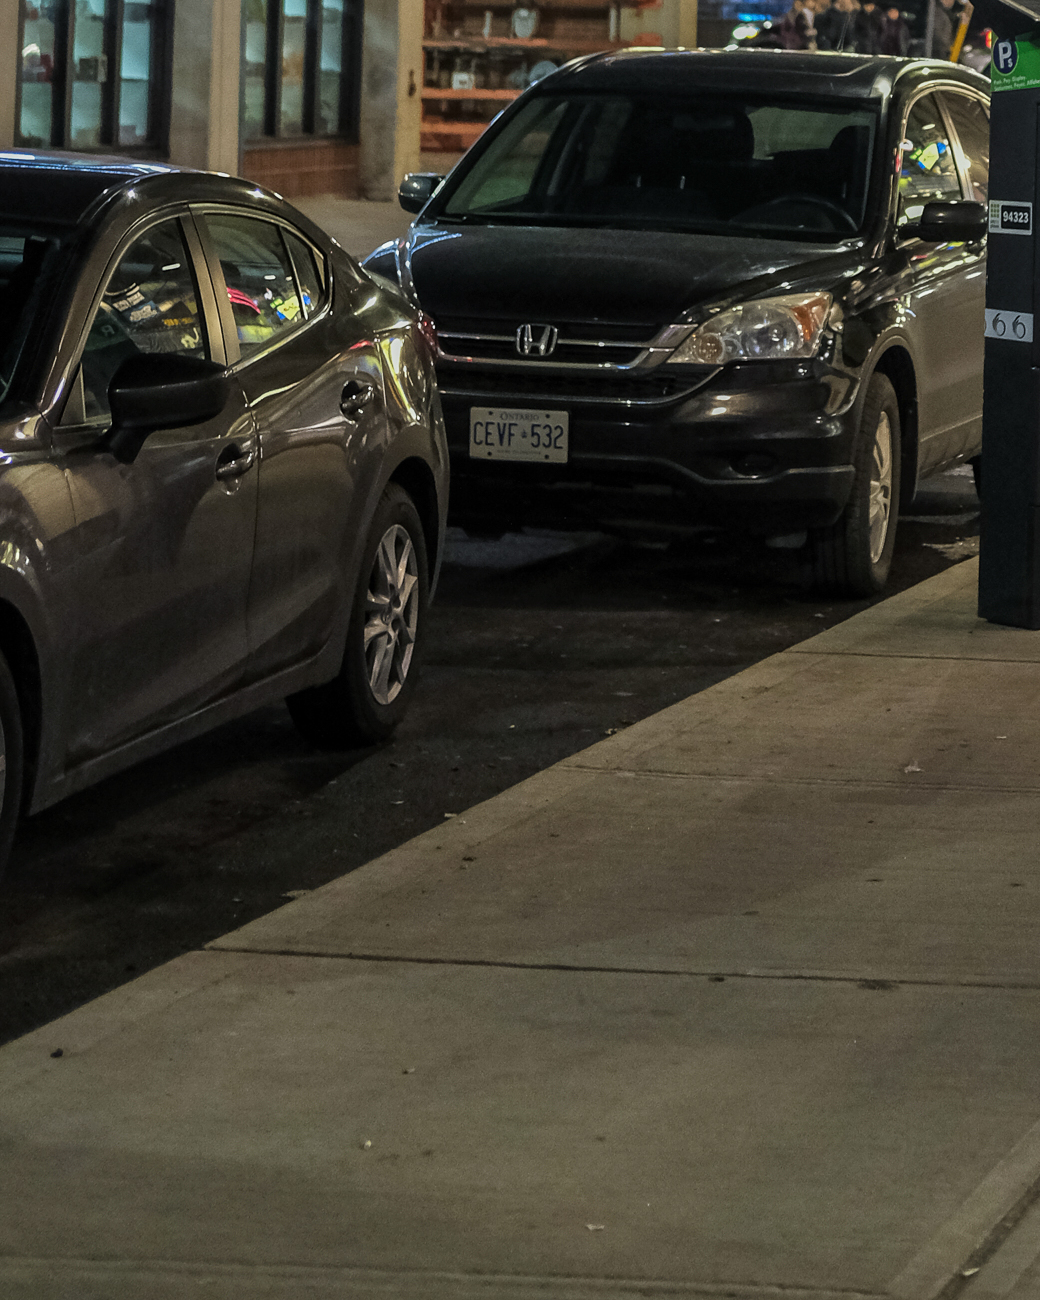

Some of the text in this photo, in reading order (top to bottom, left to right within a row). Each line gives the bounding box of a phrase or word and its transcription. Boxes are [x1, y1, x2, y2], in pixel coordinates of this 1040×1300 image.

[1002, 210, 1029, 224] 94323
[473, 421, 564, 449] CEVF 532
